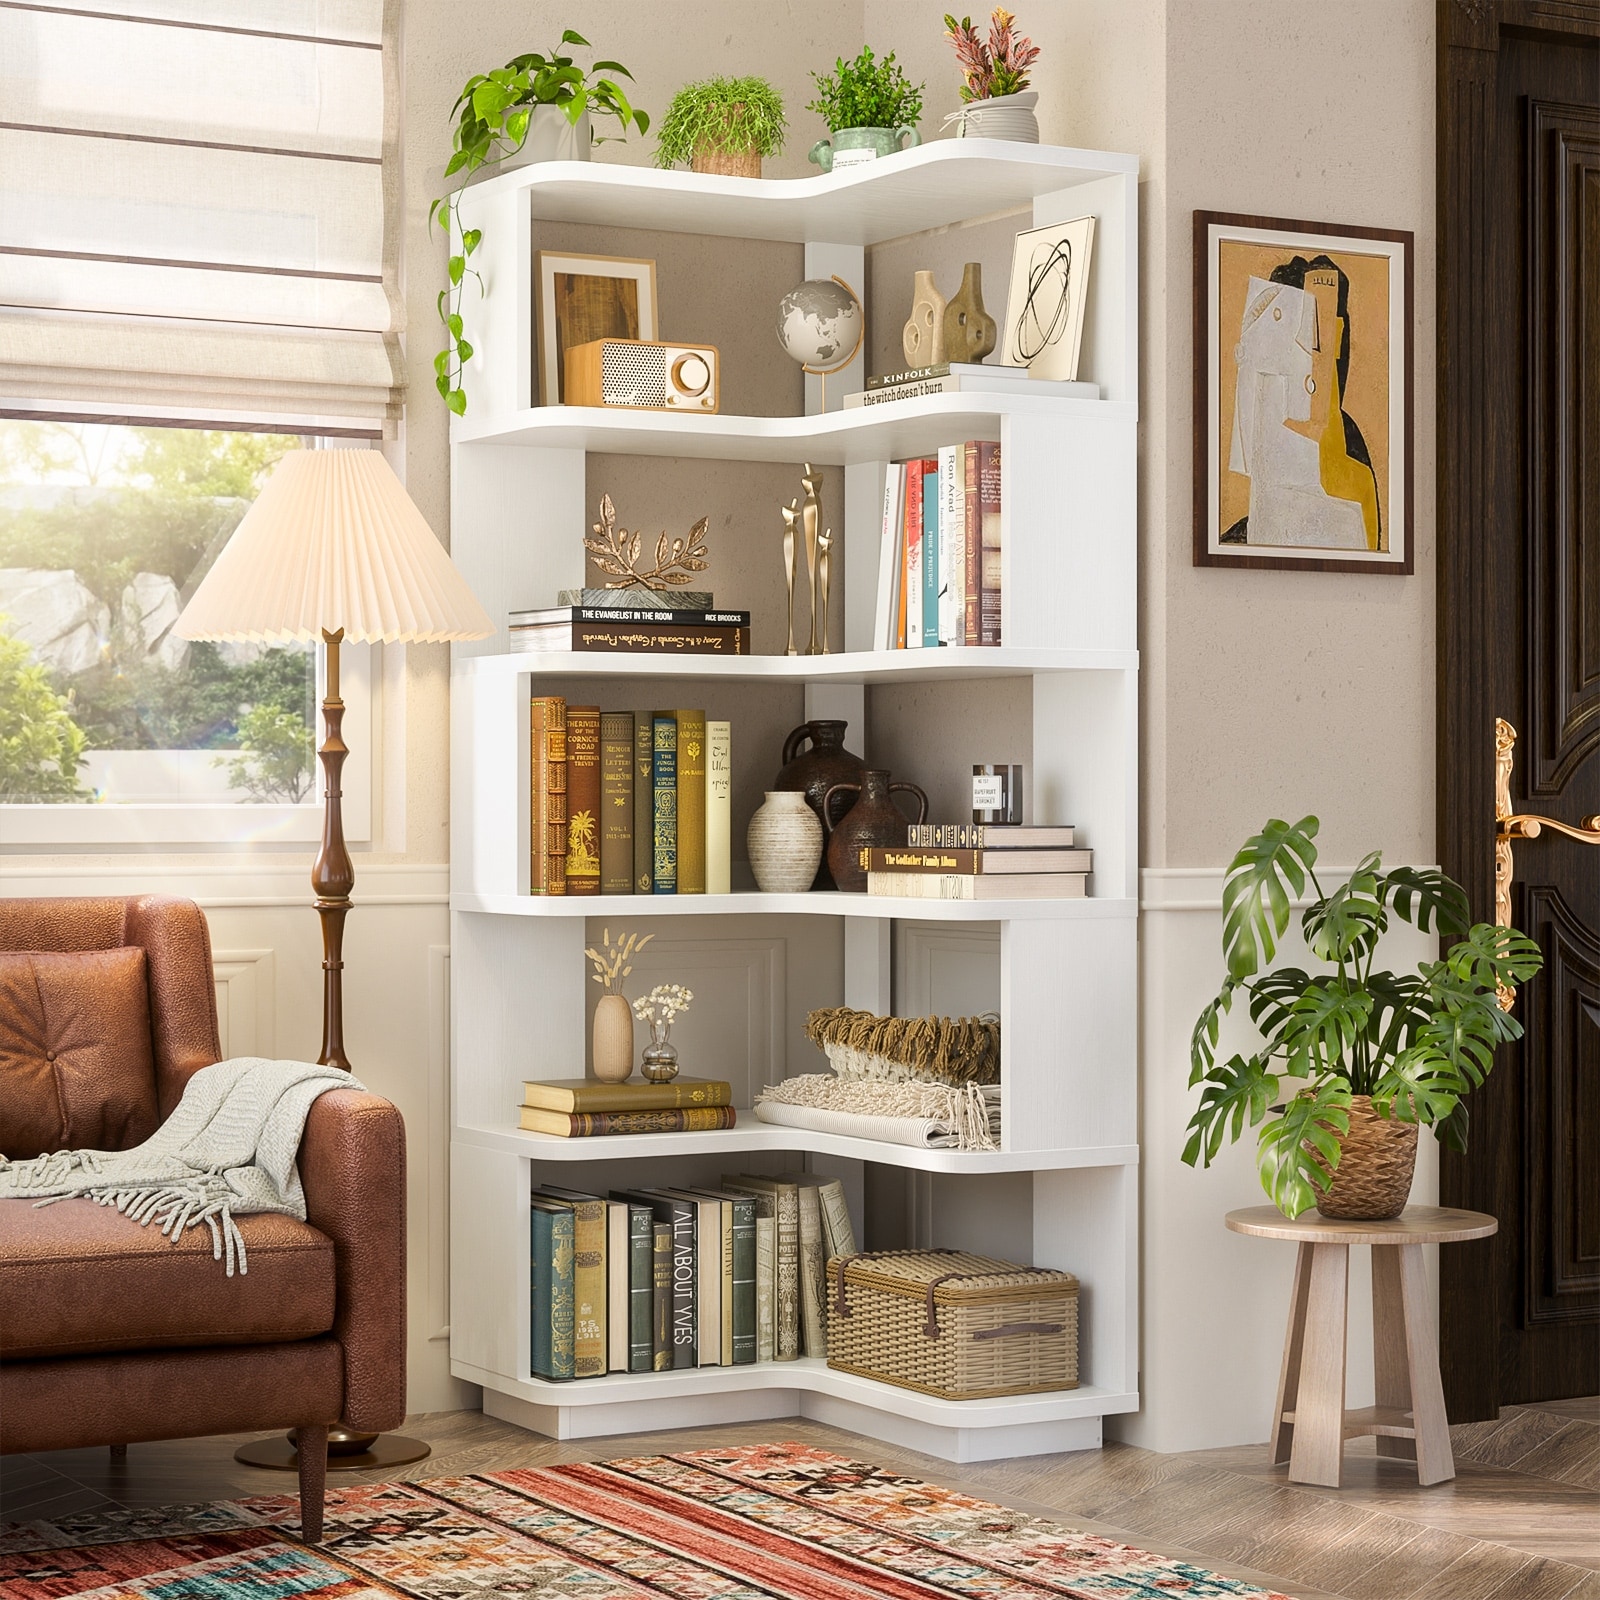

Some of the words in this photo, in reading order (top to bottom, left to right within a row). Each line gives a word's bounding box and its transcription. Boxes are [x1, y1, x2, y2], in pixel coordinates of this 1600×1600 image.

[884, 368, 932, 384] KINFOLK
[864, 394, 875, 406] the
[876, 389, 896, 403] witch
[897, 384, 924, 400] doesn't
[924, 382, 943, 395] burn
[956, 534, 964, 564] DAYS
[582, 610, 594, 618] THE
[595, 610, 632, 619] EVANGELIST
[641, 612, 653, 620] THE
[703, 636, 722, 648] Zoey
[885, 854, 895, 864] The
[896, 854, 922, 866] Godfather
[922, 855, 940, 868] Family
[940, 856, 957, 867] Album
[674, 1210, 692, 1239] ALL
[674, 1244, 692, 1298] ABOUT
[674, 1305, 692, 1345] YVES
